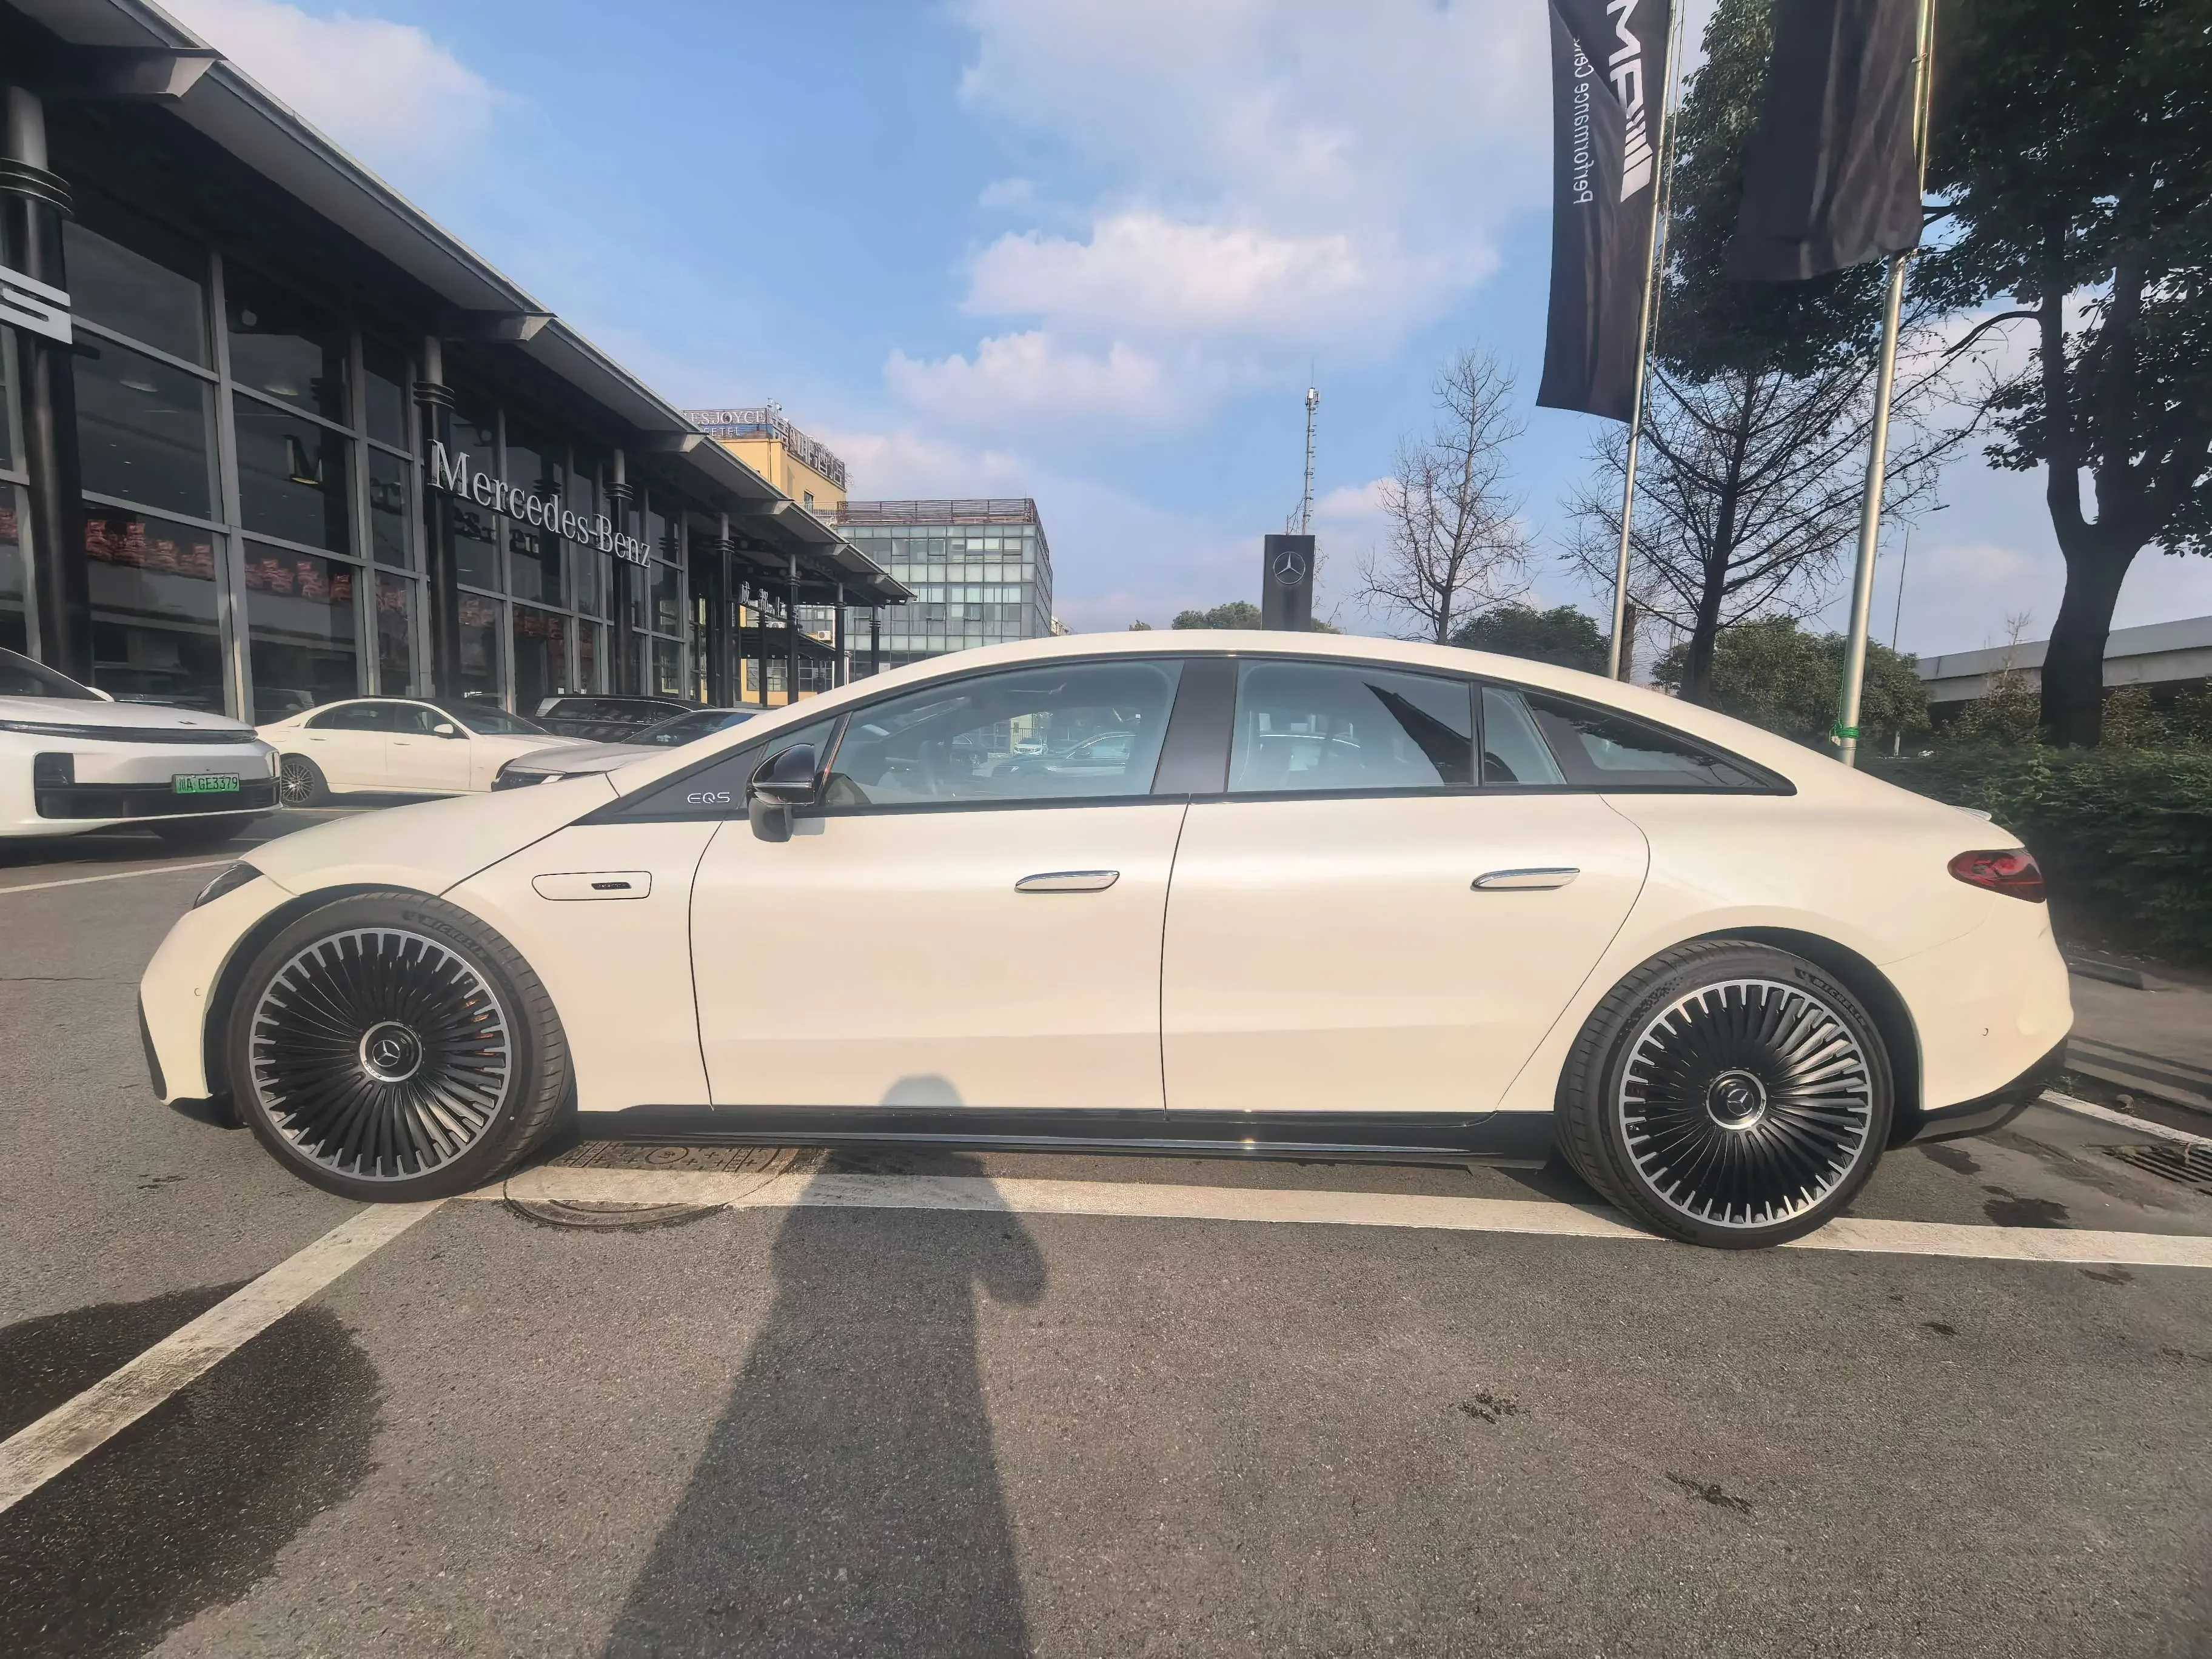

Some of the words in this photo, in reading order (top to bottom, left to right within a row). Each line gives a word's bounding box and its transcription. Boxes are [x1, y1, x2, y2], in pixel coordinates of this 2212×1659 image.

[427, 439, 651, 568] Mercedes-Benz
[198, 777, 238, 790] GE3379
[687, 792, 731, 804] EQS
